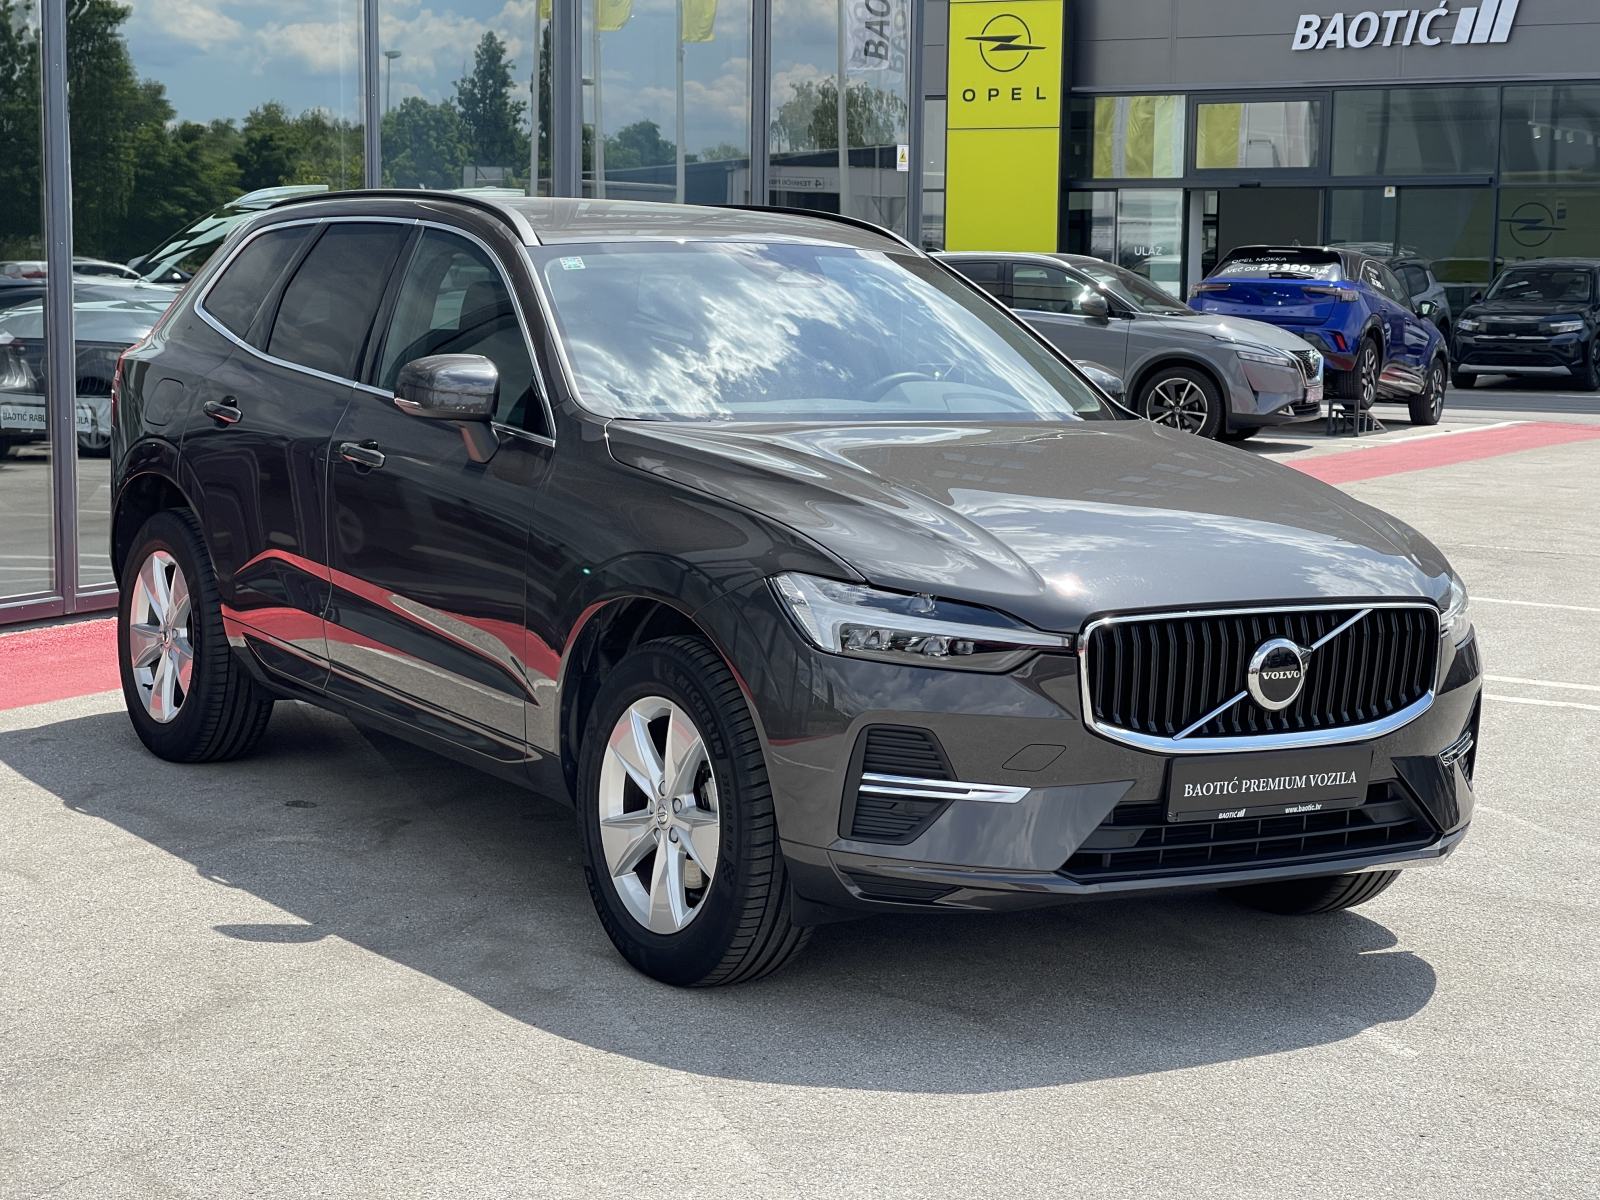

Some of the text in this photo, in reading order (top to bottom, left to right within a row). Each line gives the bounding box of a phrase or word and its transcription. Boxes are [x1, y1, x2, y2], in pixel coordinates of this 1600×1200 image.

[1291, 1, 1449, 50] BAOTIĆ
[962, 86, 1047, 102] OPEL
[1134, 246, 1162, 256] ULAZ
[1259, 263, 1278, 271] 22
[1310, 267, 1329, 275] EUR
[1262, 671, 1300, 680] VOLVO
[676, 673, 725, 755] MICHELIN
[1184, 771, 1357, 797] BAOTIĆ PREMIUM VOZILA
